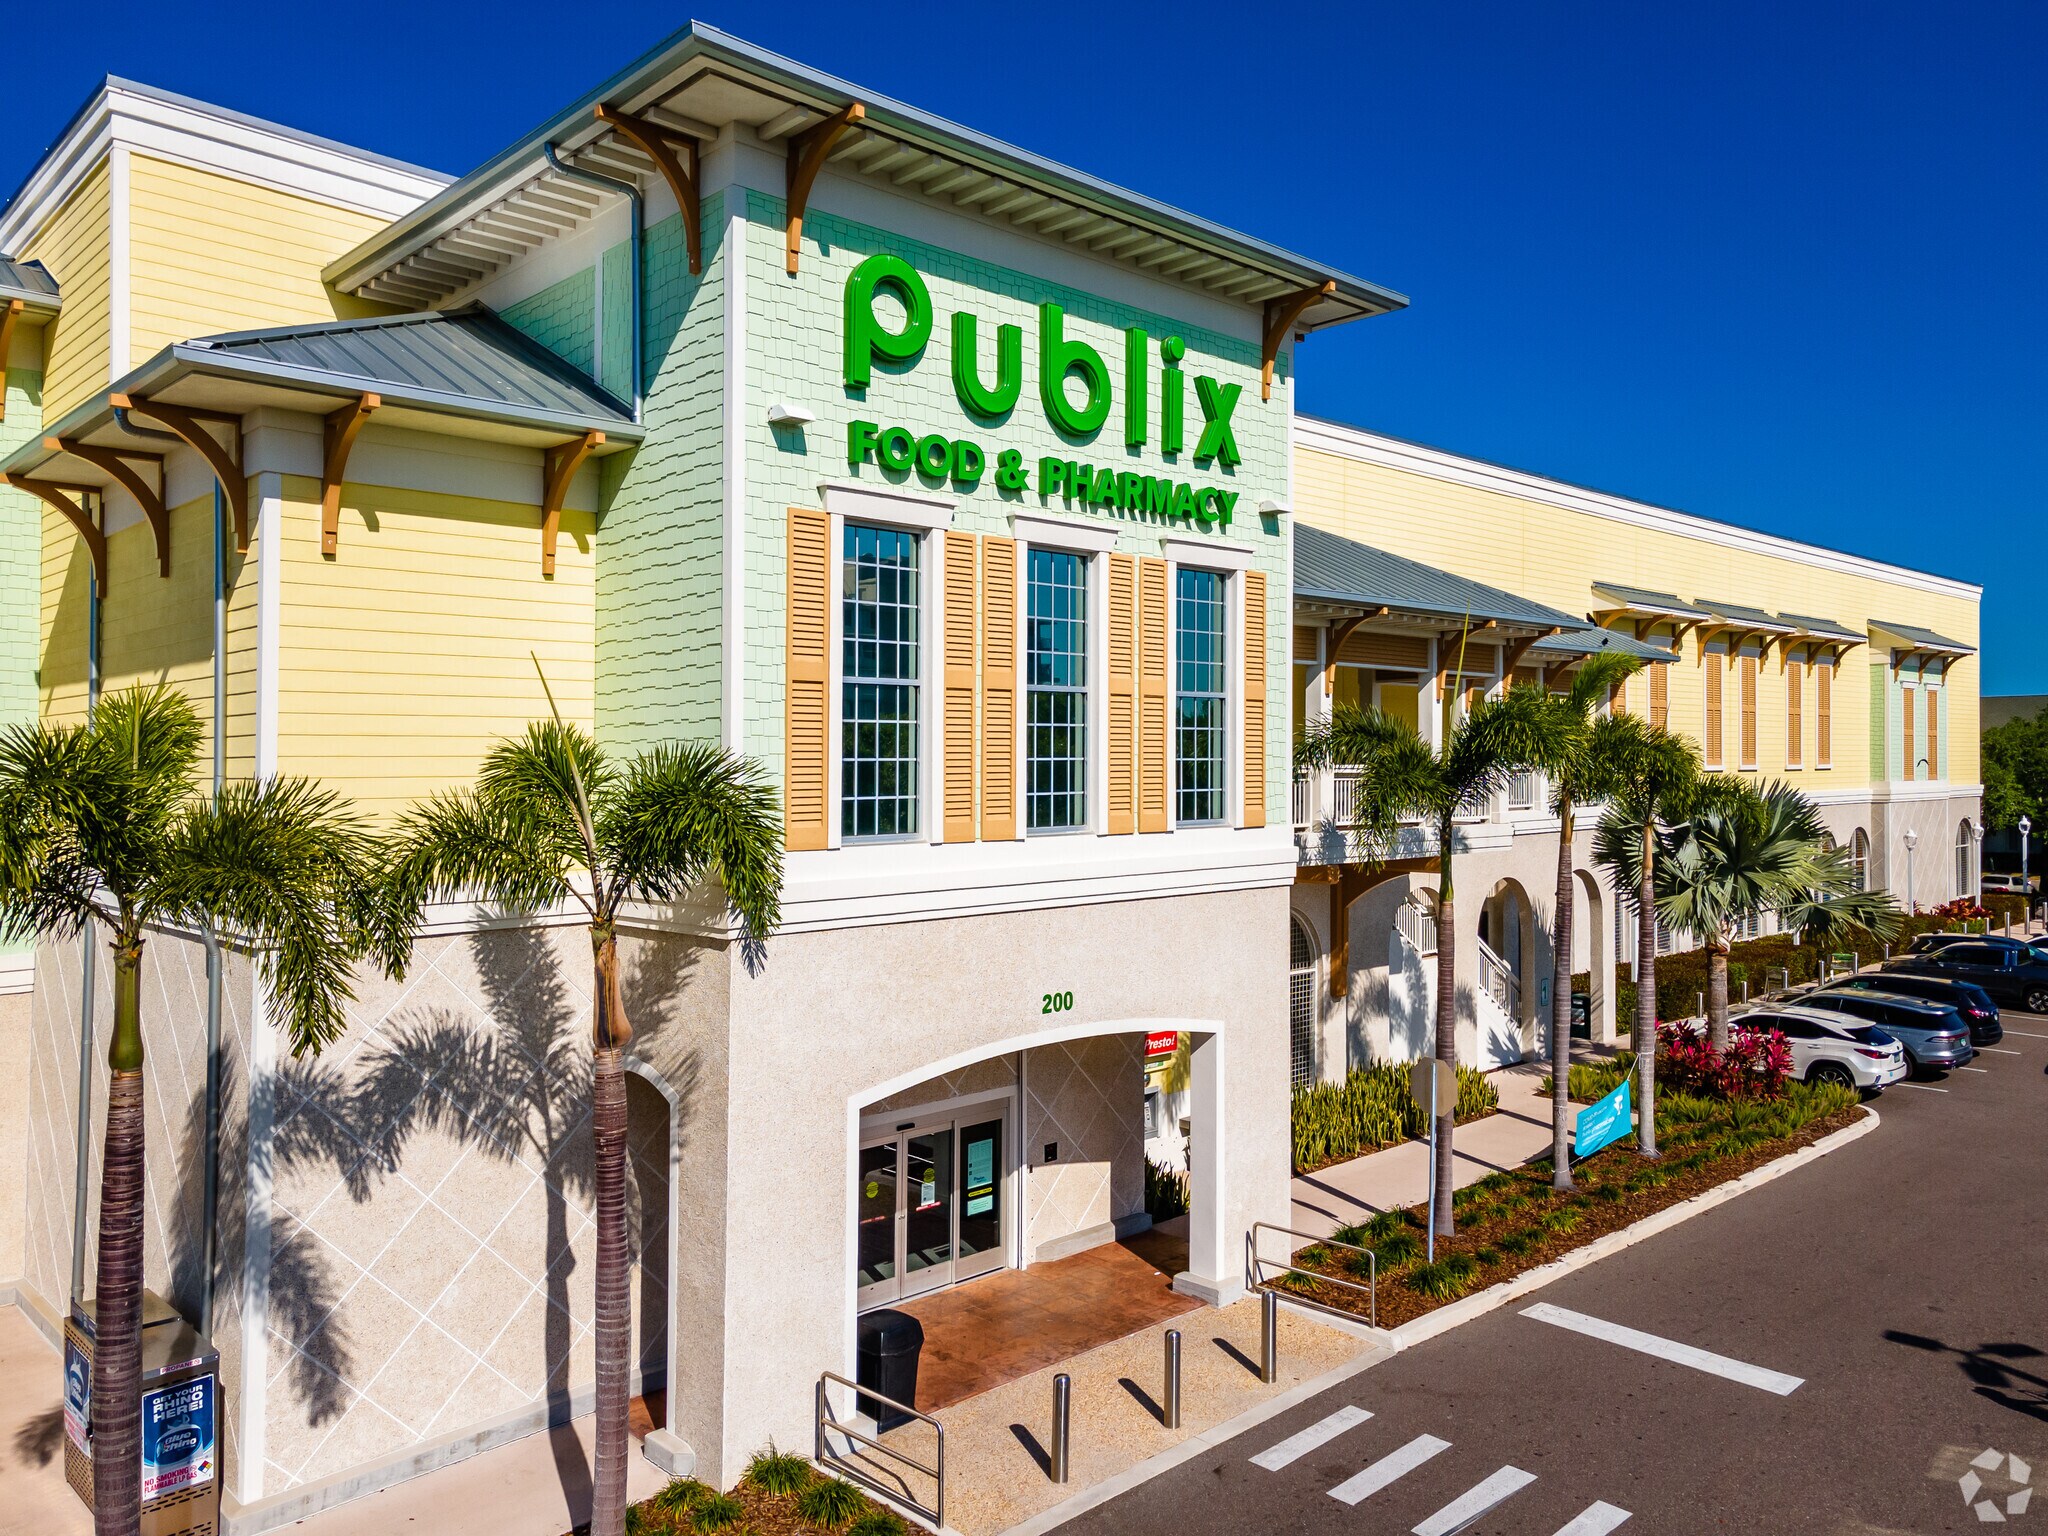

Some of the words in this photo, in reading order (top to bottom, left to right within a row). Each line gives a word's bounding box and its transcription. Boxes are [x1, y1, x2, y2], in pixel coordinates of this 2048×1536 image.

[844, 253, 1242, 466] Publix
[847, 419, 985, 481] FOOD
[995, 448, 1030, 491] &
[1038, 456, 1240, 525] PHARMACY
[1042, 991, 1074, 1014] 200
[1144, 1034, 1176, 1050] Presto!
[161, 1360, 193, 1373] PROPANE
[152, 1394, 173, 1404] GET
[175, 1384, 203, 1398] YOUR
[153, 1391, 203, 1414] RHINO
[153, 1399, 203, 1423] HERE!
[144, 1478, 155, 1487] NO
[156, 1466, 189, 1482] SMOKING
[144, 1477, 177, 1494] FLAMMABLE
[186, 1470, 198, 1481] GAS
